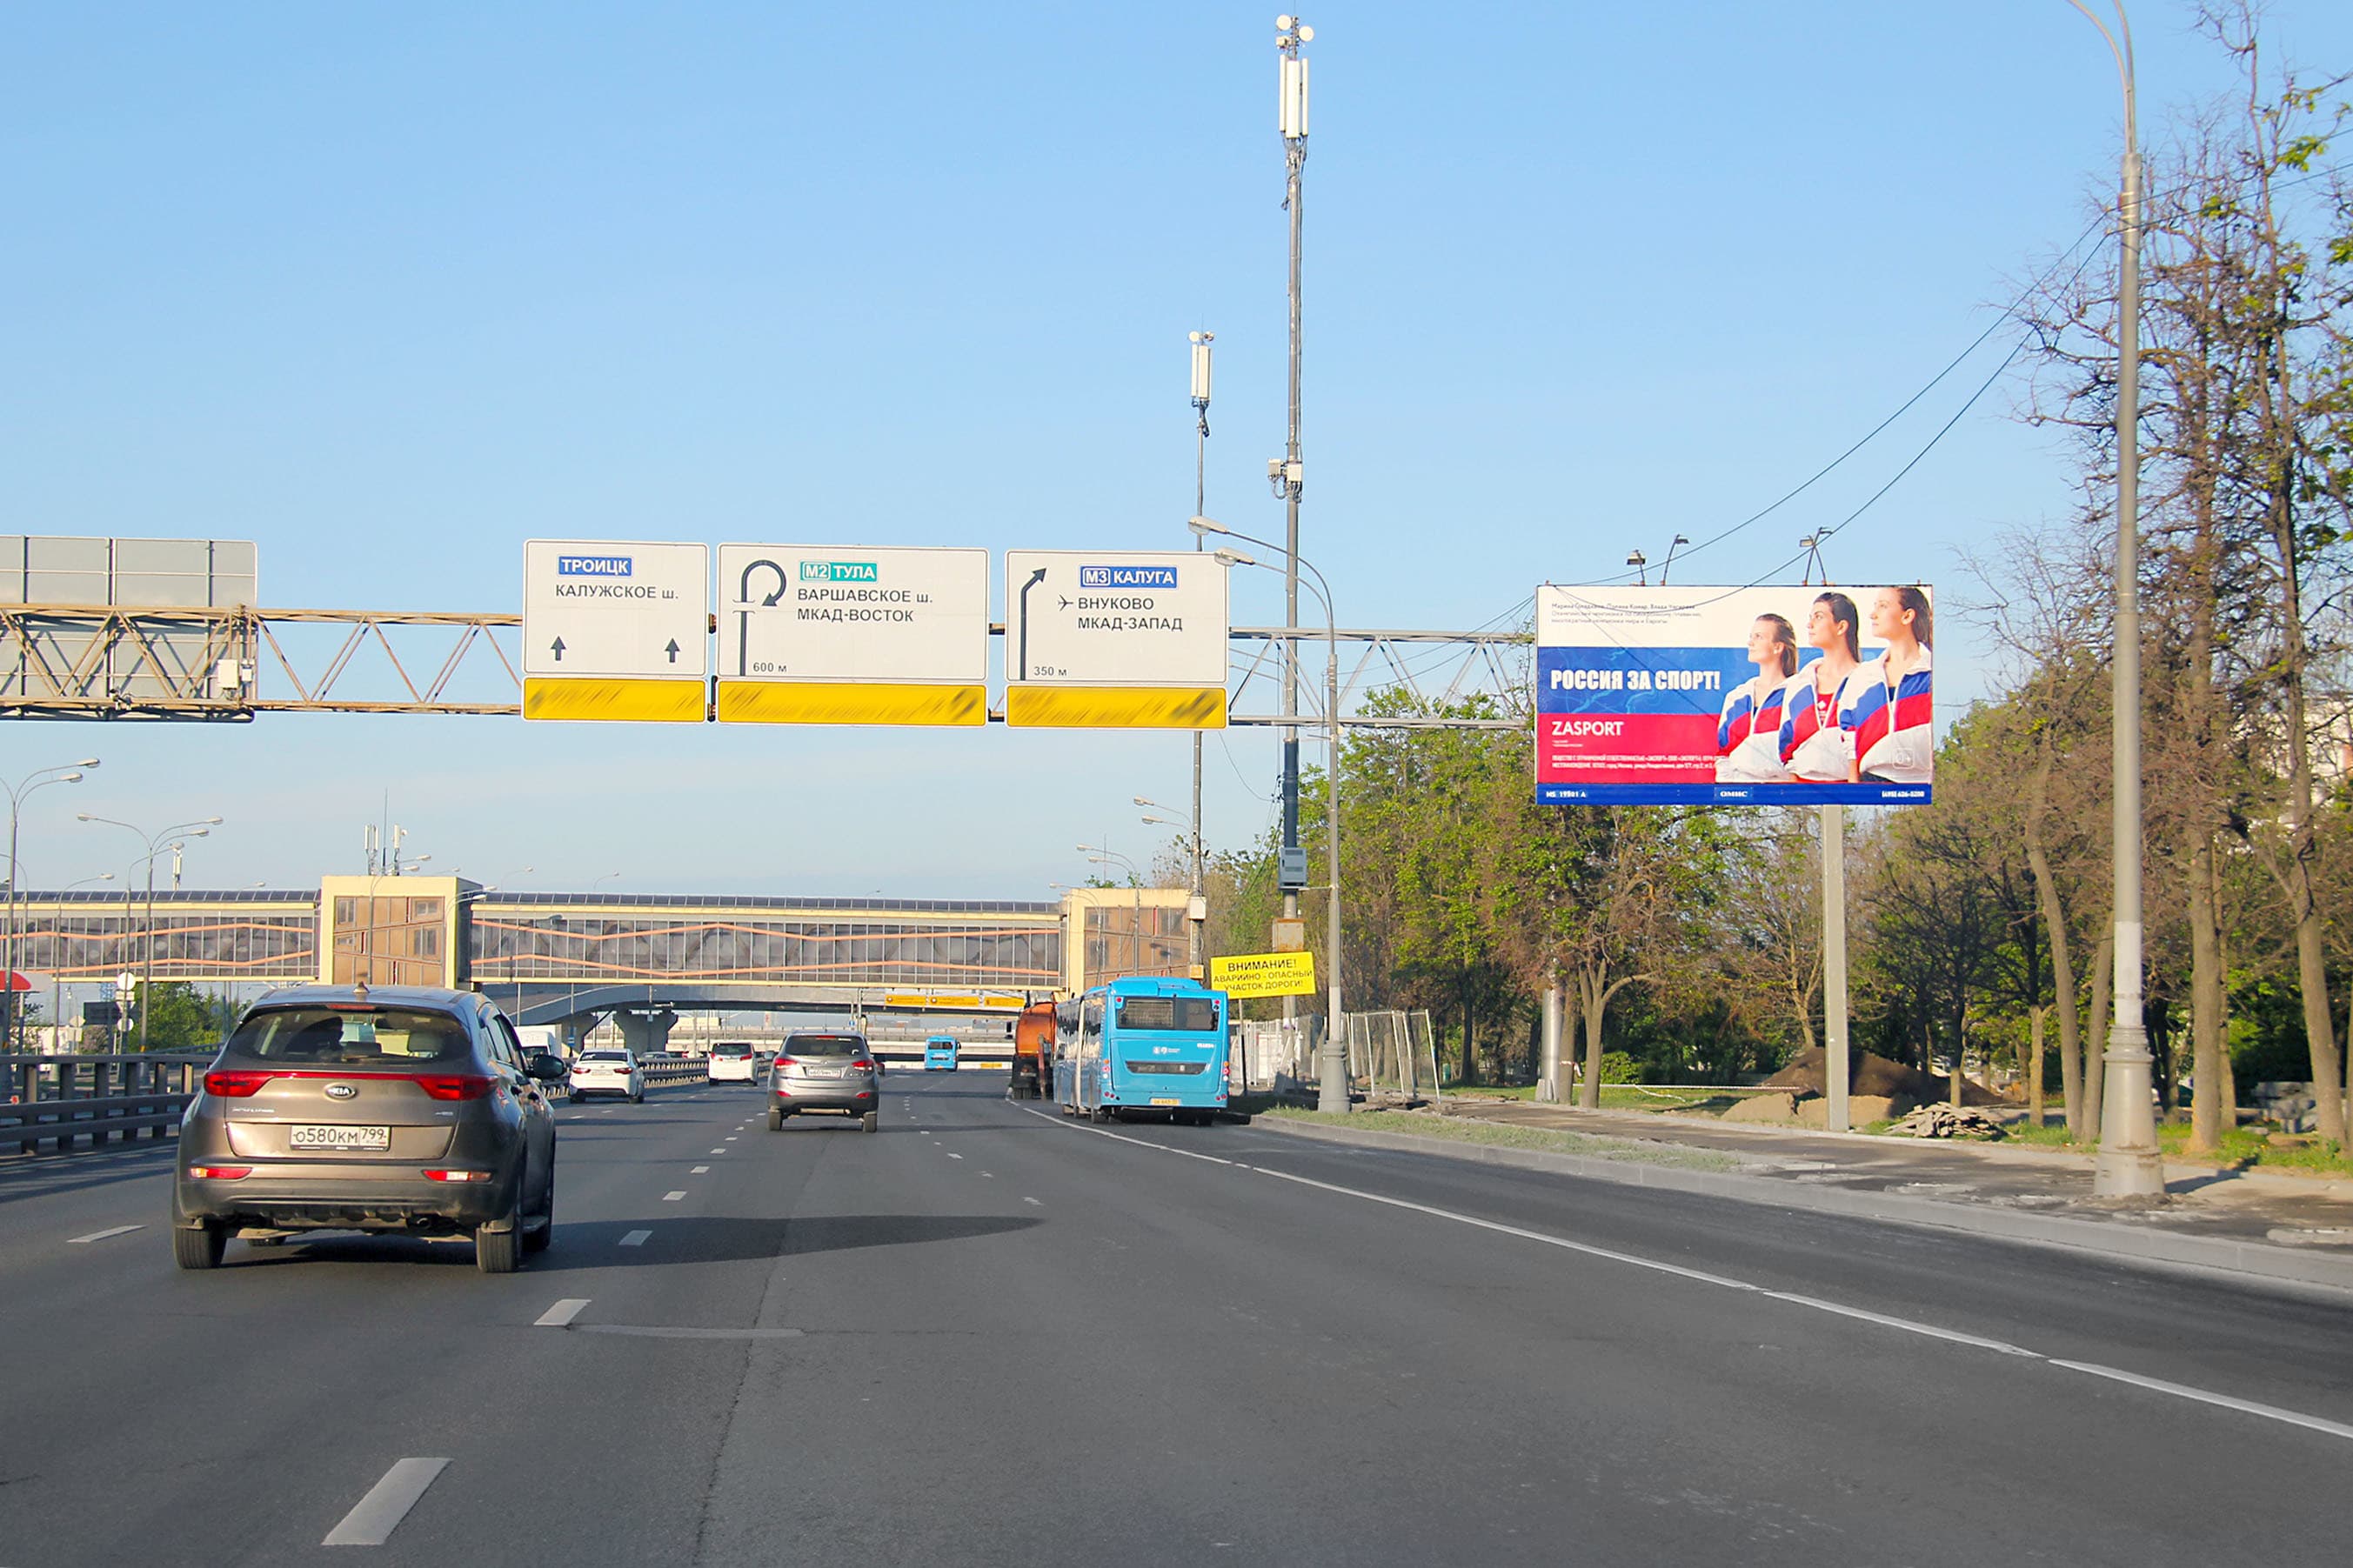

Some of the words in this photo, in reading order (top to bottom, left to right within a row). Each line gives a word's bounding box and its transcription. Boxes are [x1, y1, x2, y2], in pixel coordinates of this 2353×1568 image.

[561, 559, 628, 575] ТРОИЦК
[806, 565, 827, 578] М2
[833, 565, 876, 579] ТУЛА
[1086, 570, 1108, 584] М3
[1113, 570, 1174, 584] КАЛУГА
[555, 584, 657, 599] КАЛУЖСКОЕ
[662, 588, 679, 600] ш.
[798, 588, 912, 603] ВАРШАВСКОЕ
[916, 592, 933, 604] ш.
[1078, 597, 1154, 611] ВНУКОВО
[797, 608, 913, 623] МКАД-ВОСТОК
[1078, 617, 1183, 631] МКАД-ЗАПАД
[752, 662, 774, 672] 600
[1033, 666, 1054, 677] 350
[1551, 670, 1623, 690] РОССИЯ
[1627, 671, 1652, 690] ЗА
[1654, 671, 1721, 690] СПОРТ!
[1551, 721, 1624, 736] ZASPORT
[1227, 958, 1297, 972] ВНИМАНИЕ!
[1213, 973, 1260, 983] АВАРИЙНО
[1268, 971, 1313, 979] ОПАСНЫЙ
[1266, 980, 1303, 990] ДОРОГИ!
[330, 1086, 351, 1096] KIA
[361, 1128, 385, 1140] 799
